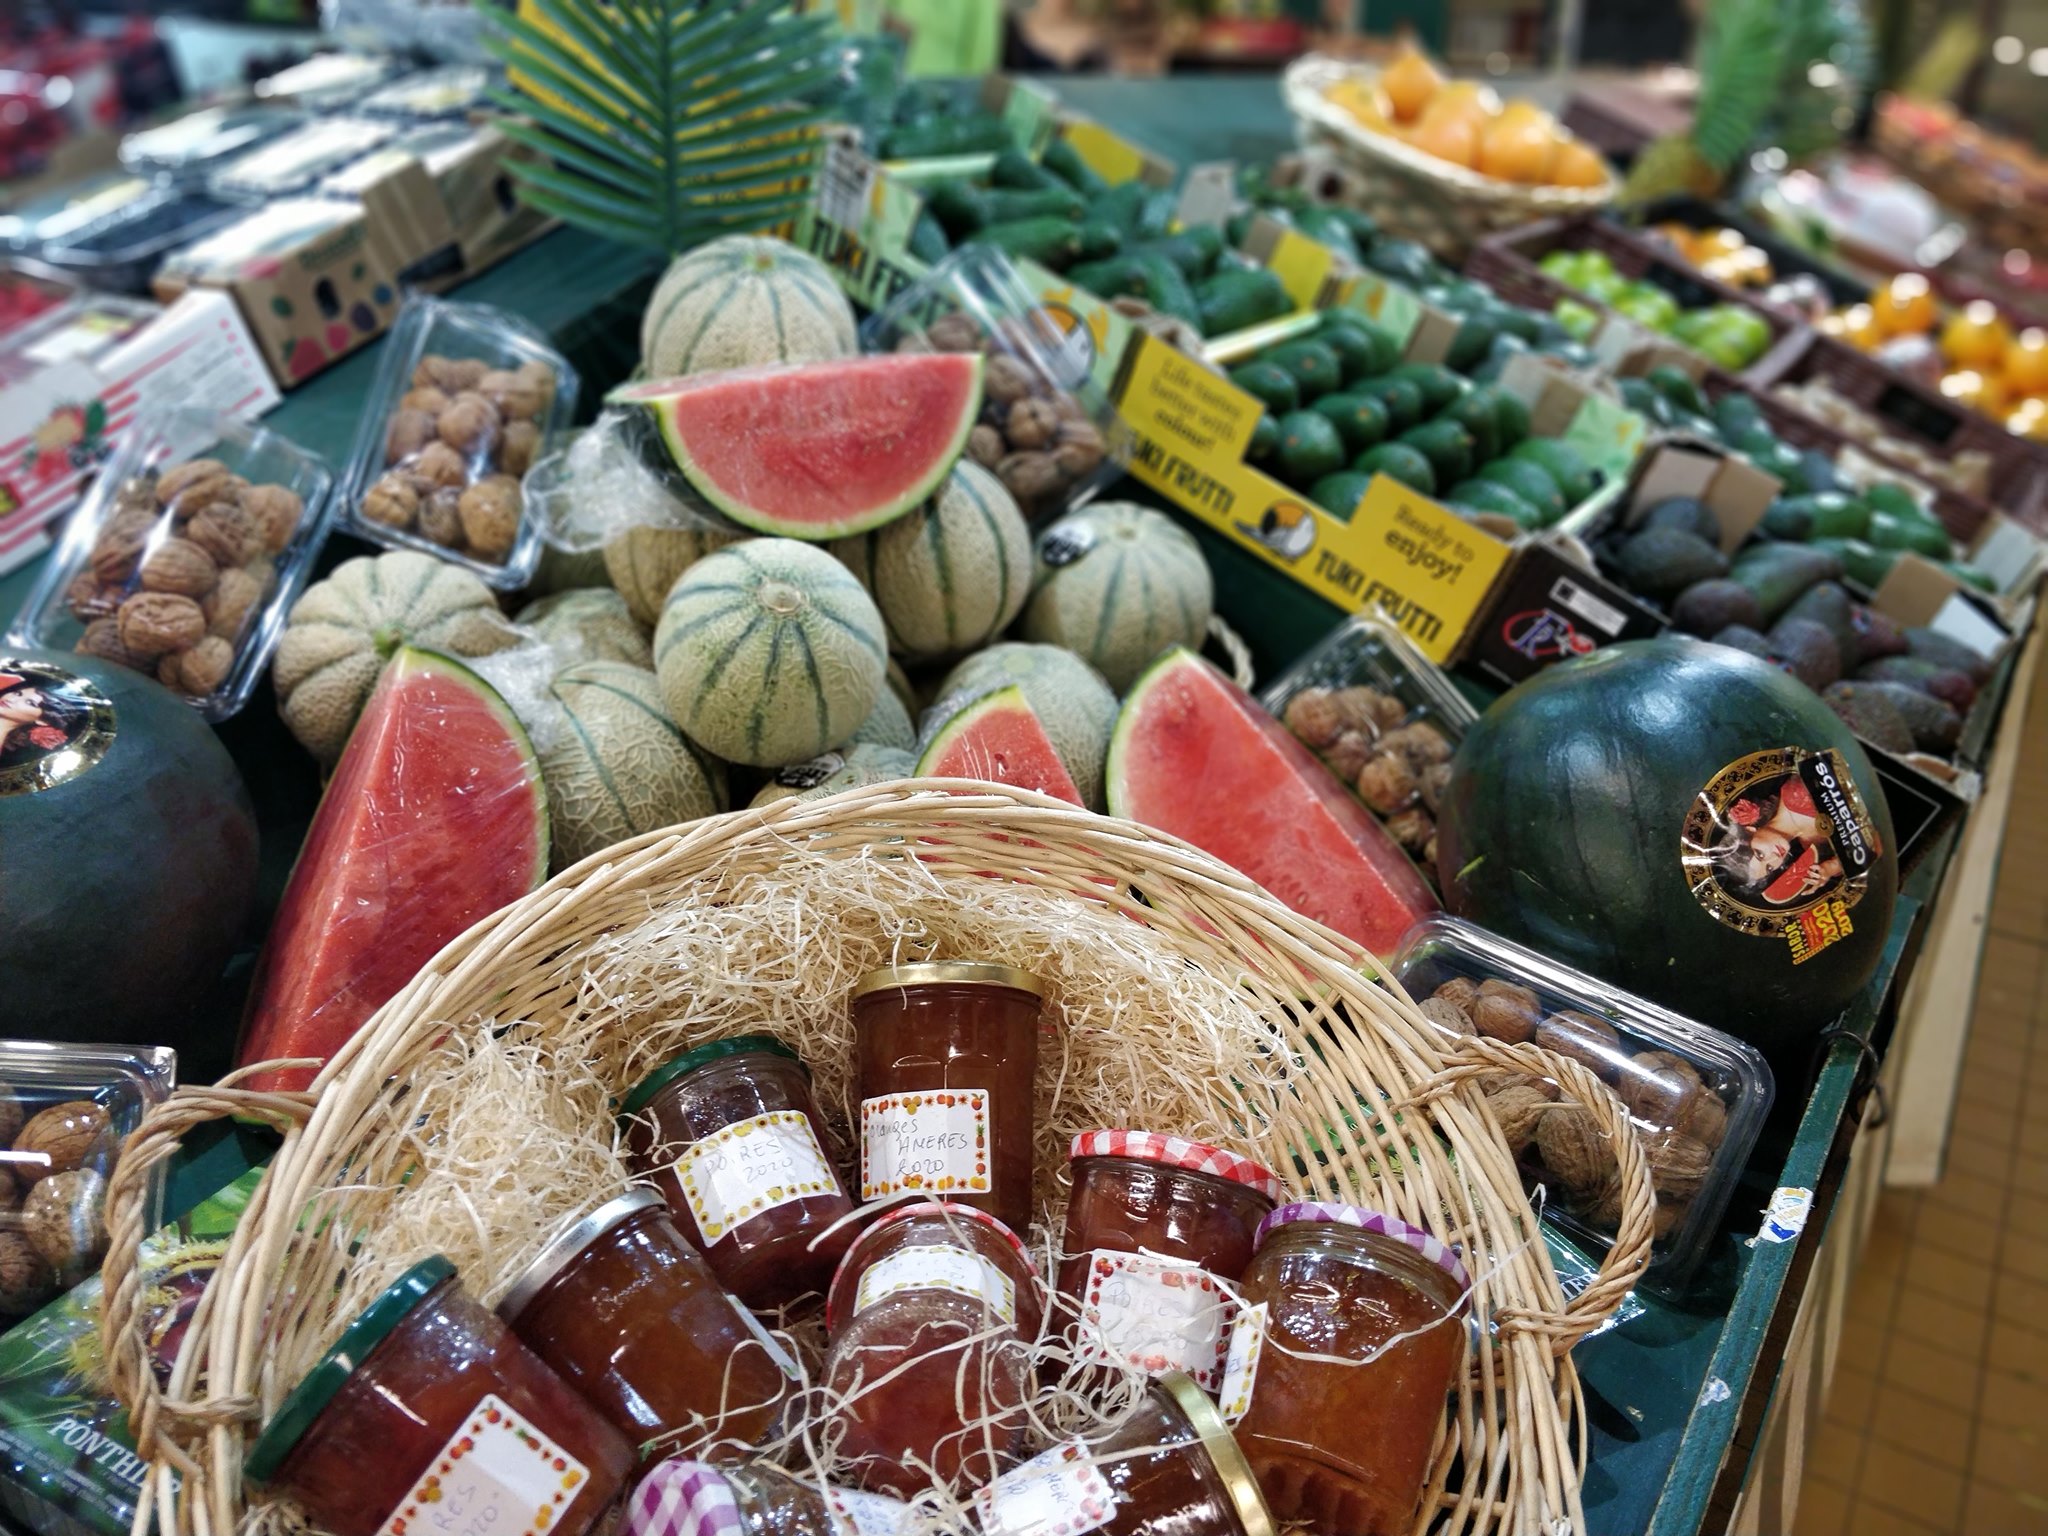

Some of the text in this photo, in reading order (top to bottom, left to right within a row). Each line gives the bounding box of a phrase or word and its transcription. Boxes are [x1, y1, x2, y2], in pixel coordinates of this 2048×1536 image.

[1200, 408, 1237, 444] with
[1163, 454, 1236, 515] FRUTTI
[1394, 503, 1475, 563] Ready to
[1384, 529, 1464, 585] enjoy!
[1314, 548, 1366, 597] TUKI
[1361, 579, 1444, 643] FRUTTI
[1815, 762, 1866, 865] Caparrós
[1820, 792, 1850, 847] PREMIUM
[1785, 921, 1806, 958] SABOR
[1812, 902, 1841, 947] 2020
[1831, 901, 1854, 938] 2019
[897, 1132, 968, 1156] AMERES
[744, 1157, 794, 1183] 2020
[895, 1159, 944, 1176] 2020
